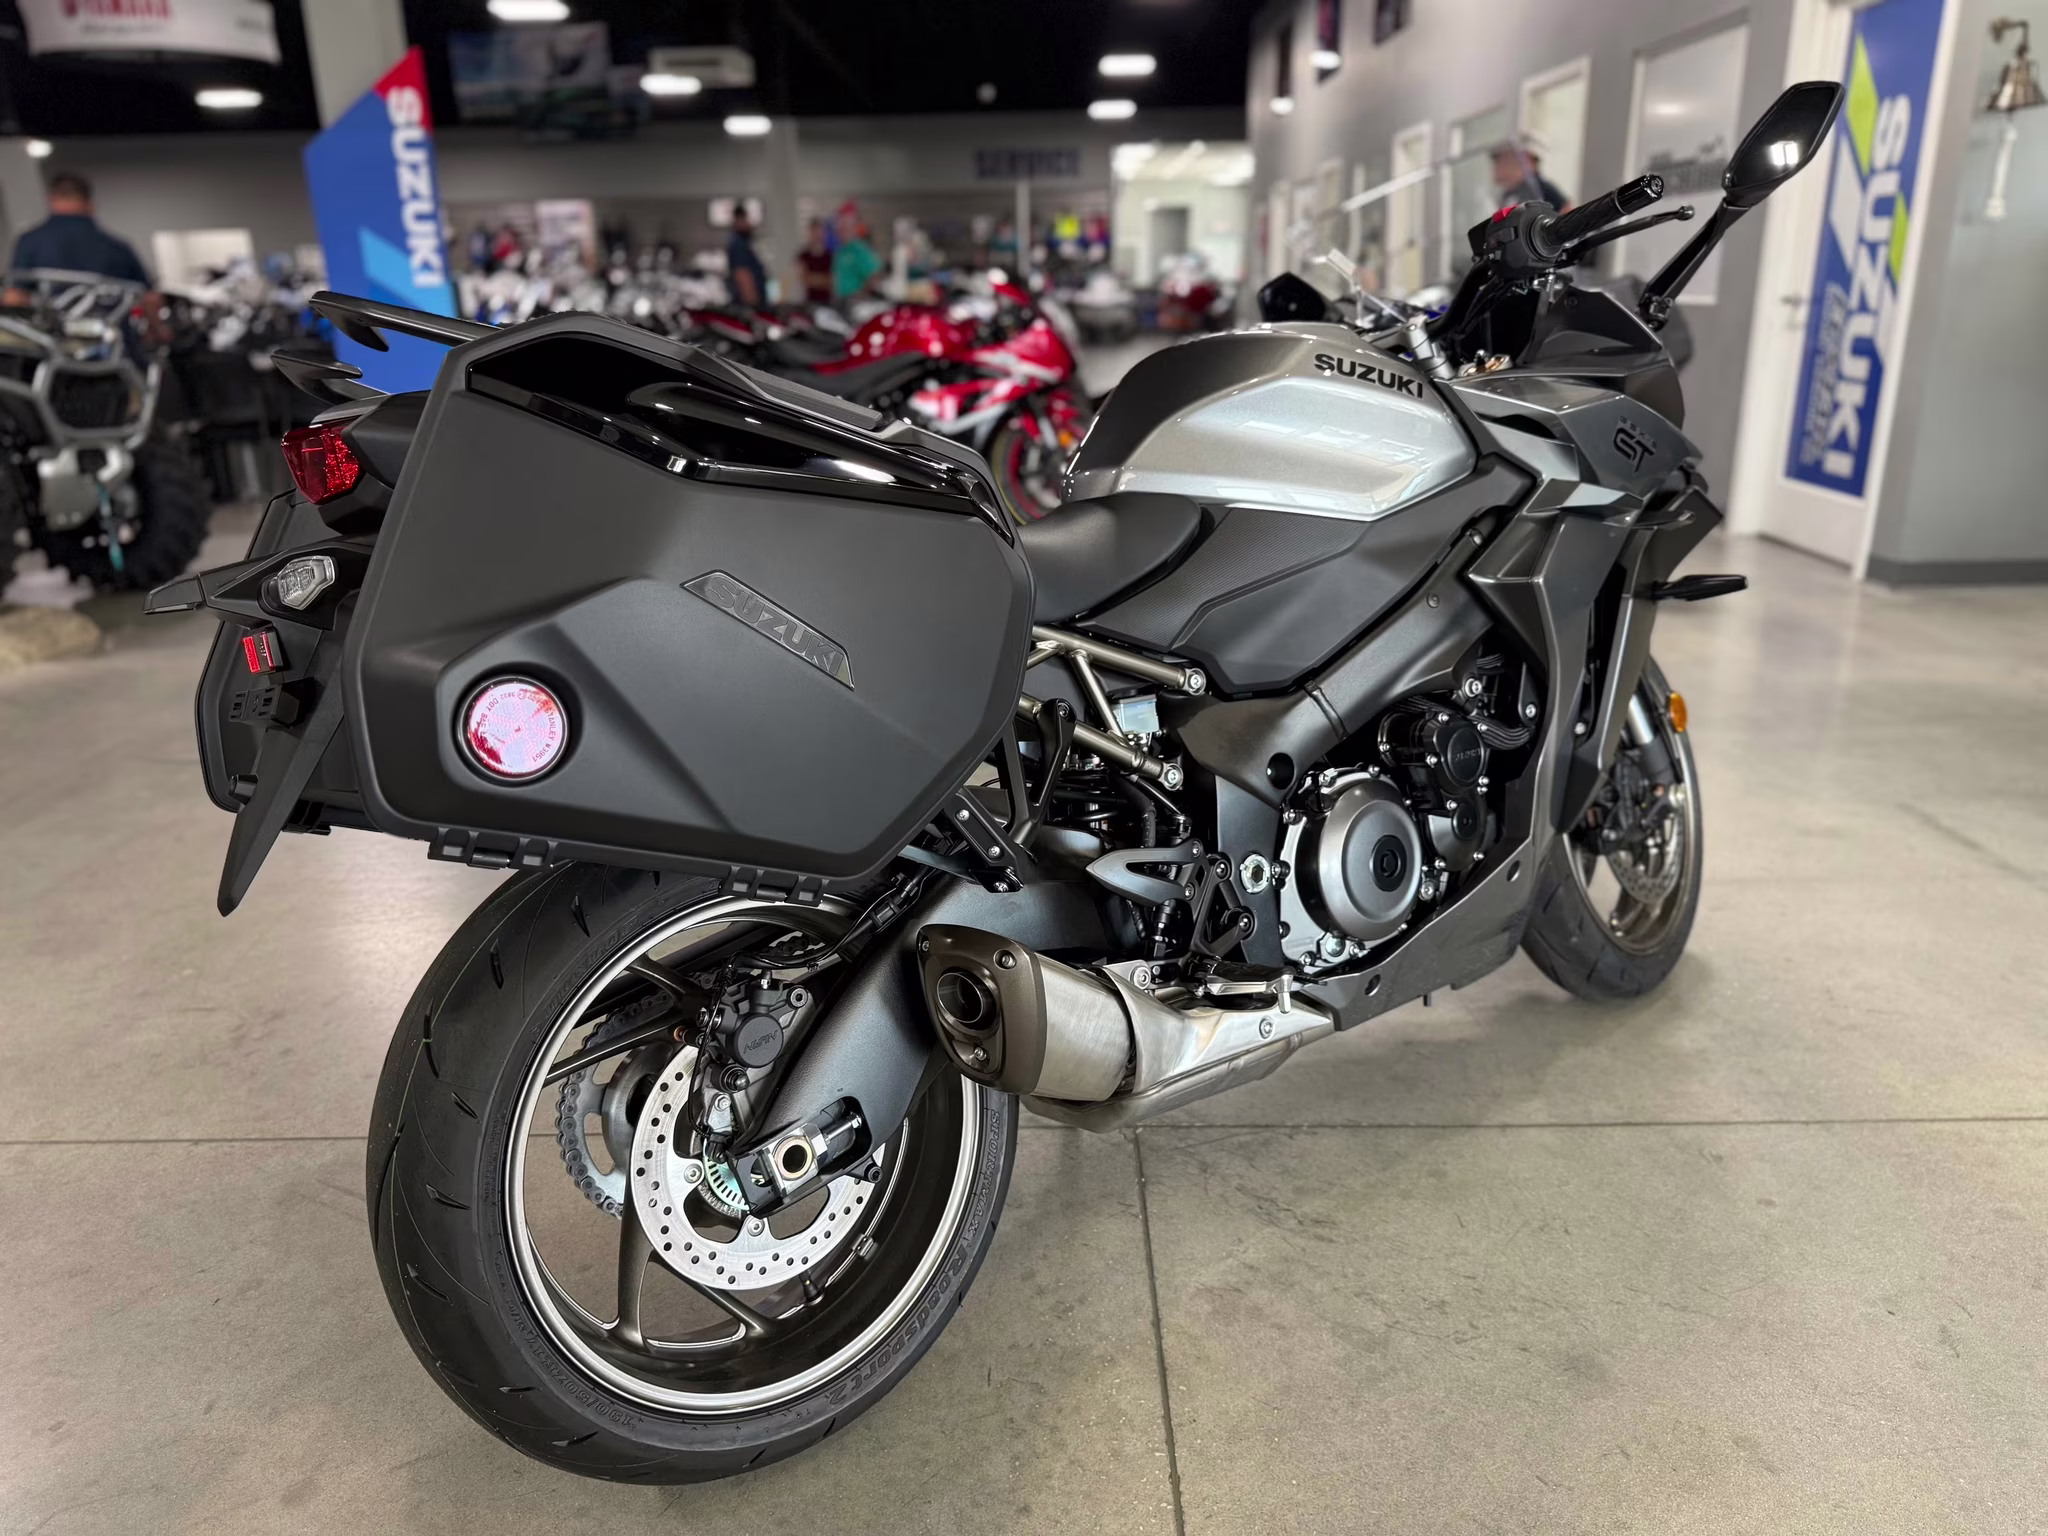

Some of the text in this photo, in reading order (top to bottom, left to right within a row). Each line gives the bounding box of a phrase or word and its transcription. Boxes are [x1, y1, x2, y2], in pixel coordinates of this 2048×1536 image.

[386, 86, 445, 288] SUZUKI
[1821, 94, 1911, 480] SUZUKI
[1313, 353, 1423, 399] SUZUKI
[706, 576, 844, 677] SUZUKI
[828, 1108, 1001, 1406] SPORTMAX Roadsport 2
